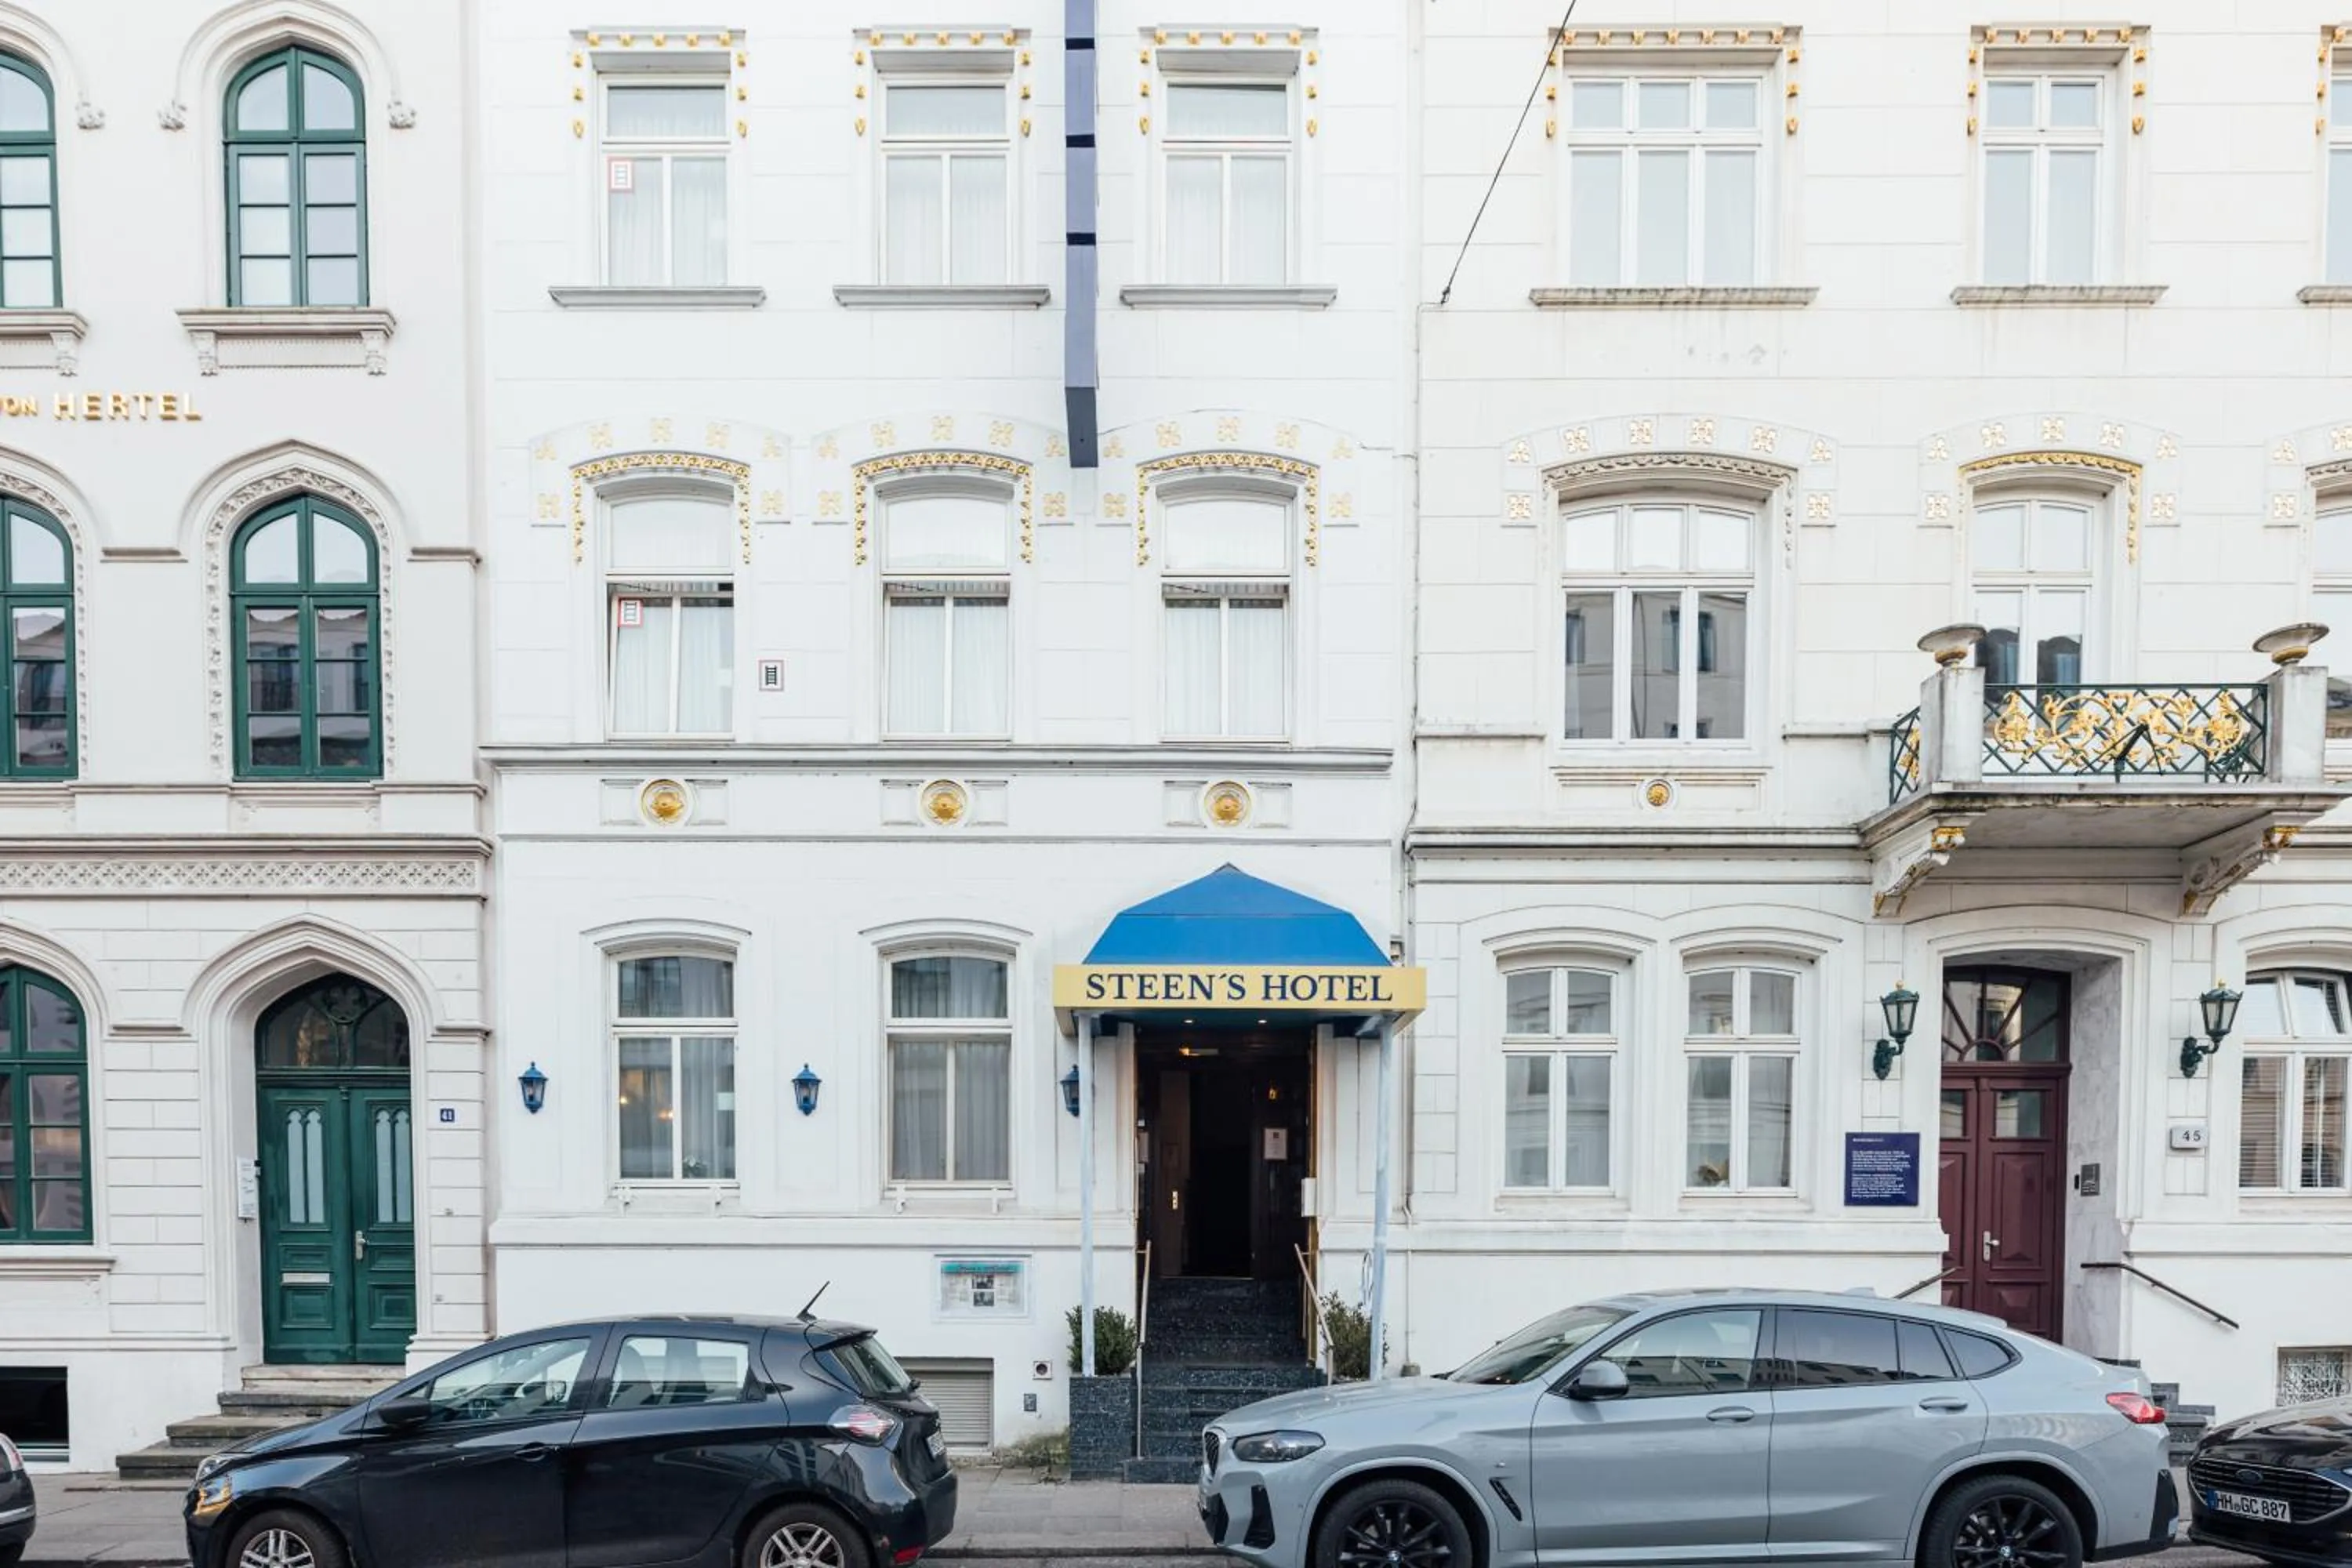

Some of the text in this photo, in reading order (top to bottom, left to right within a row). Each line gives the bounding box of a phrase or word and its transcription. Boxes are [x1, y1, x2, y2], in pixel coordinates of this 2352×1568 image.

[0, 394, 202, 421] ON HERTEL
[1261, 975, 1393, 1001] HOTEL
[2217, 1494, 2287, 1519] HH GC 887
